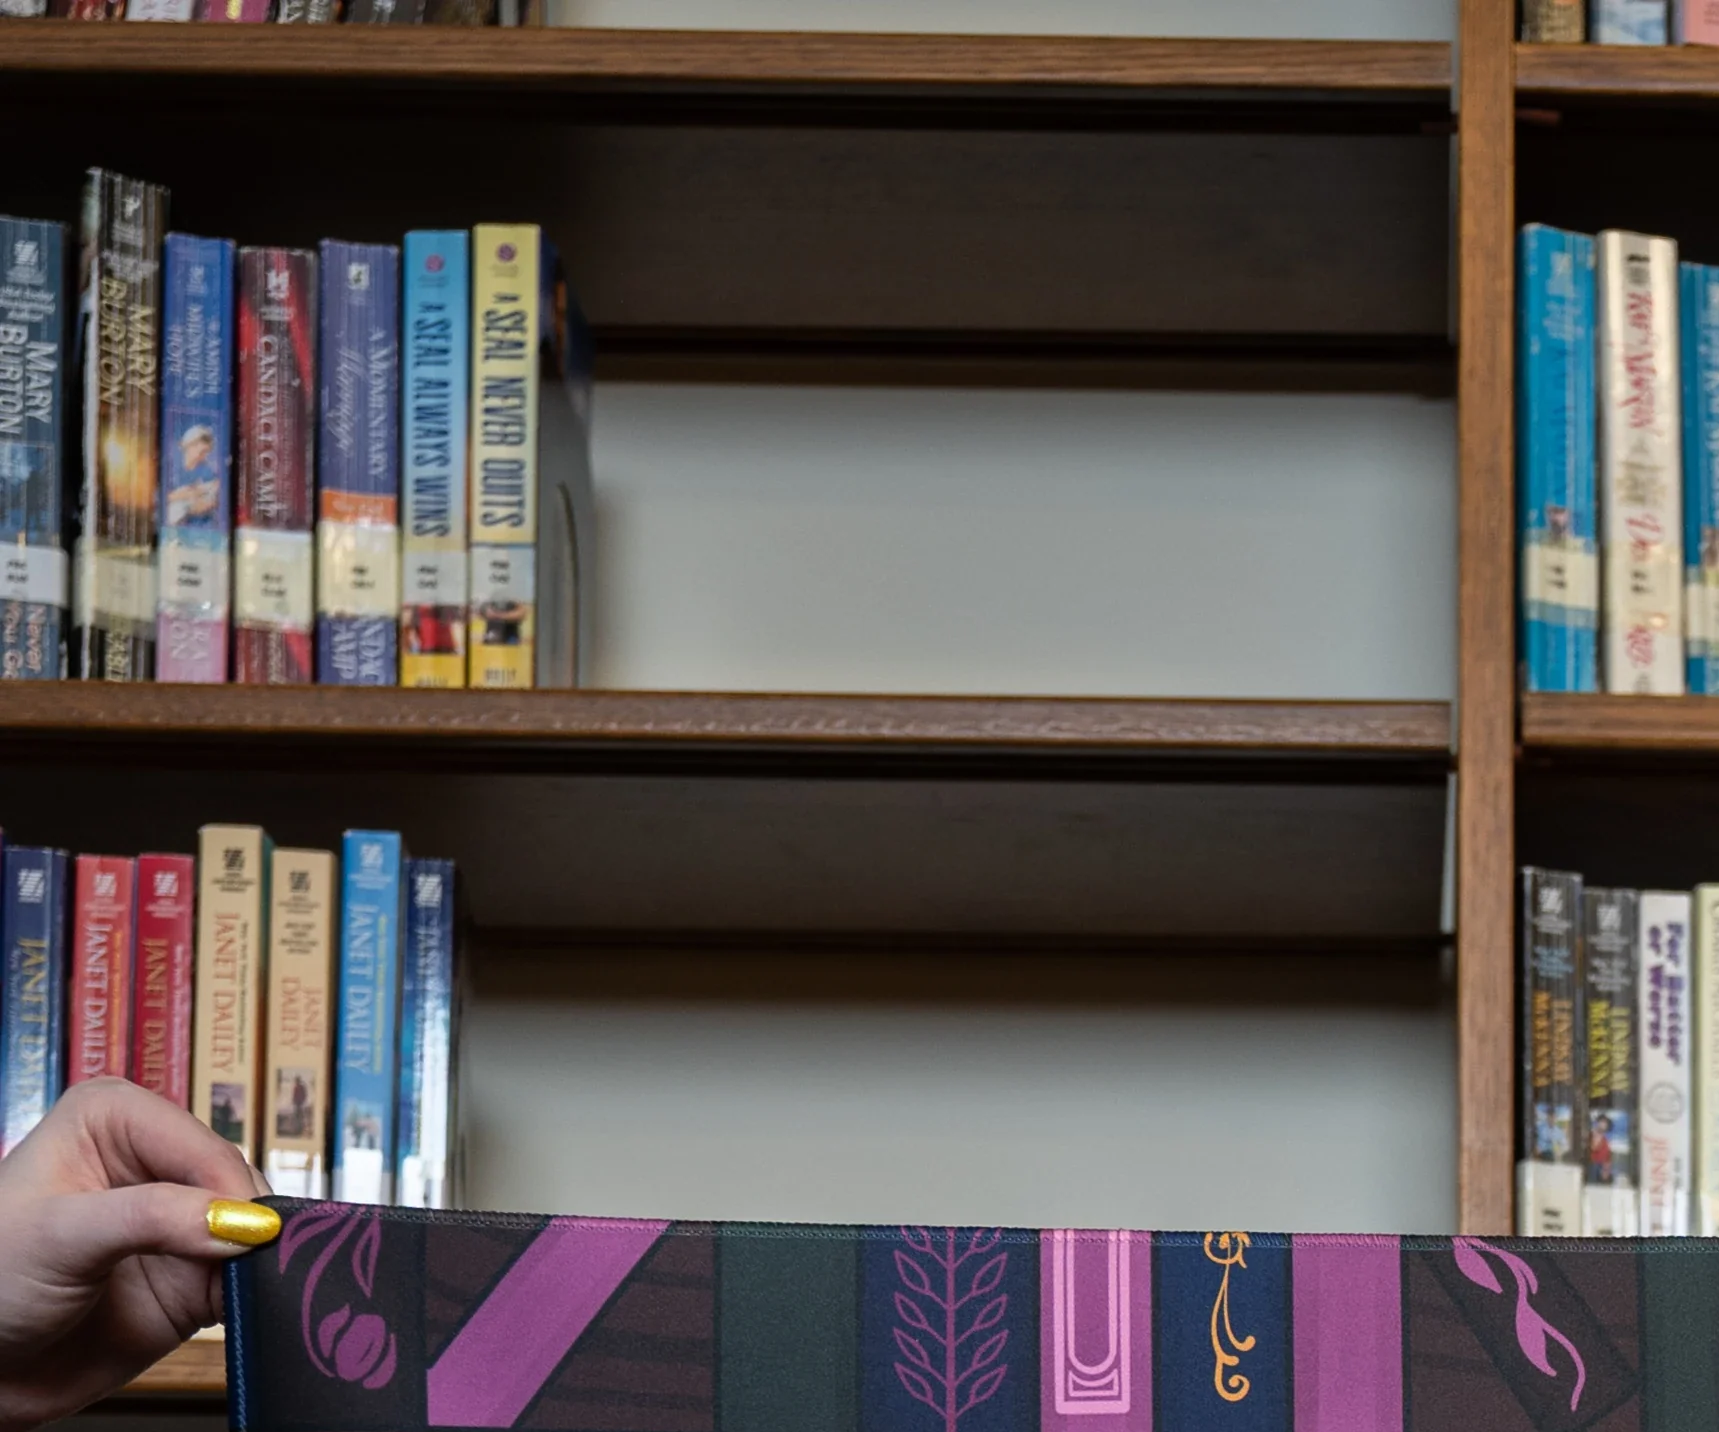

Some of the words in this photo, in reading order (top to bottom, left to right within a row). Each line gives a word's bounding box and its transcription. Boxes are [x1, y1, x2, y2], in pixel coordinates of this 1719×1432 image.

[98, 275, 132, 405] BURTON
[125, 307, 158, 395] MARY
[412, 318, 449, 367] SEAL
[482, 309, 528, 363] SEAL
[27, 342, 58, 424] MARY
[480, 375, 527, 447] NEVER
[411, 378, 450, 468] ALWAYS
[410, 476, 447, 538] WINS
[477, 457, 525, 528] QUITS
[85, 924, 110, 988] JANET
[143, 938, 168, 1007] JANET
[214, 913, 238, 980] JANET
[349, 905, 378, 975] JANET
[1665, 923, 1684, 968] For
[82, 997, 107, 1077] DAILEY
[212, 993, 237, 1072] DAILEY
[280, 977, 300, 1049] DAILEY
[303, 988, 323, 1048] JANET
[345, 985, 376, 1072] DAILEY
[1650, 966, 1665, 1050] Worse
[1666, 976, 1684, 1065] Better
